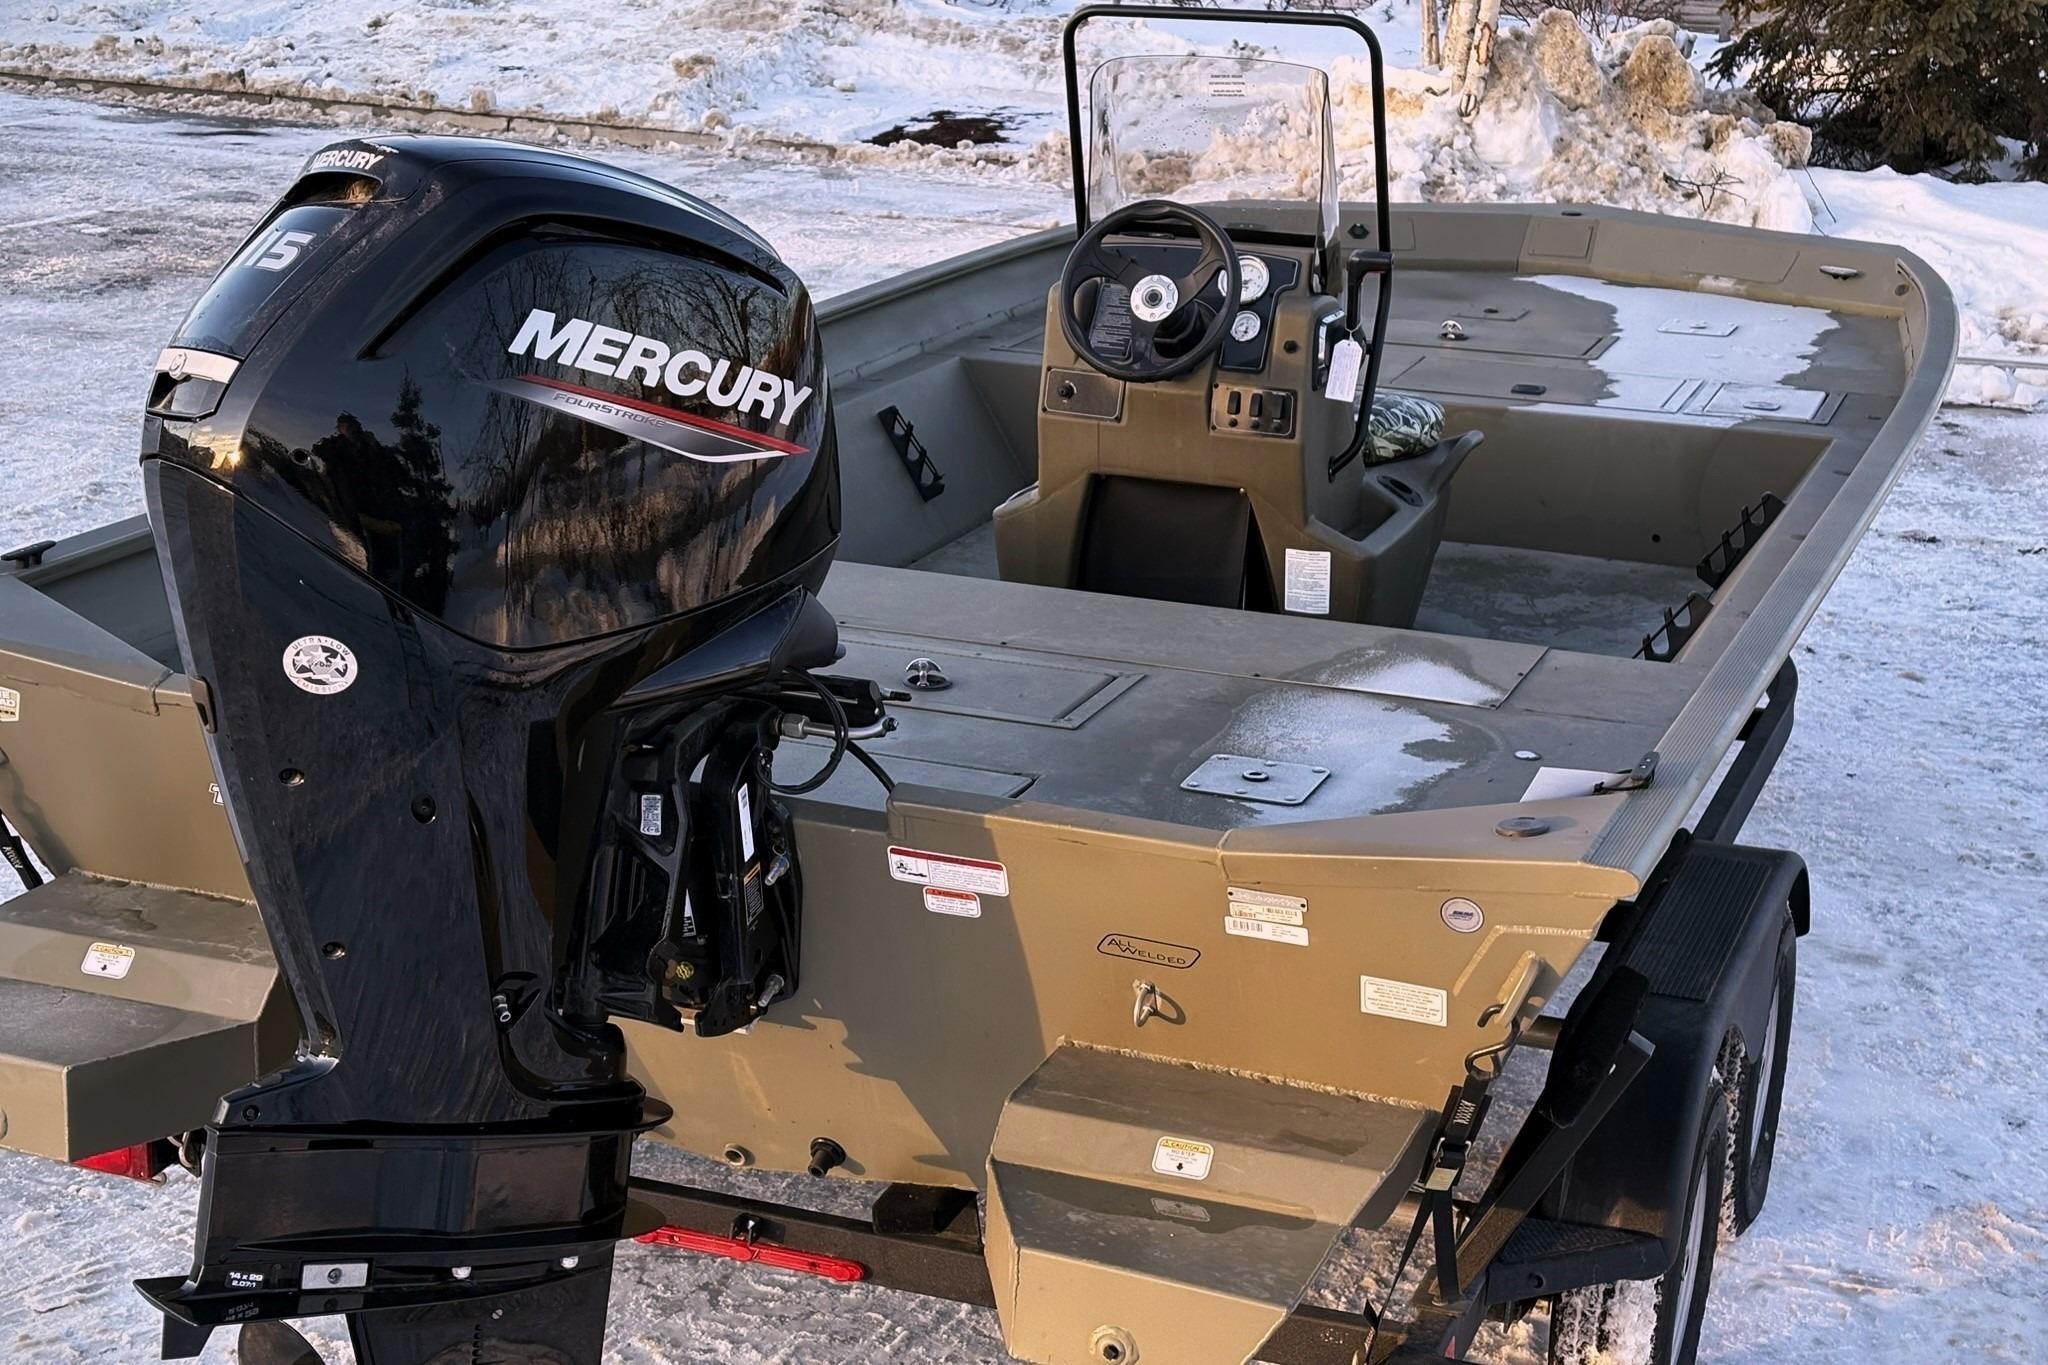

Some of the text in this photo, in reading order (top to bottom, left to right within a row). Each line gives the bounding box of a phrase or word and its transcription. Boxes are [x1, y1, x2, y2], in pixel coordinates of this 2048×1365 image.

[309, 150, 384, 170] MERCURY
[508, 308, 813, 426] MERCURY
[552, 392, 666, 428] FOURSTROKE
[292, 637, 351, 656] ULTRA LOW
[1107, 938, 1136, 948] ALL
[1117, 946, 1186, 965] WELDED
[1171, 1142, 1200, 1151] CAUTION
